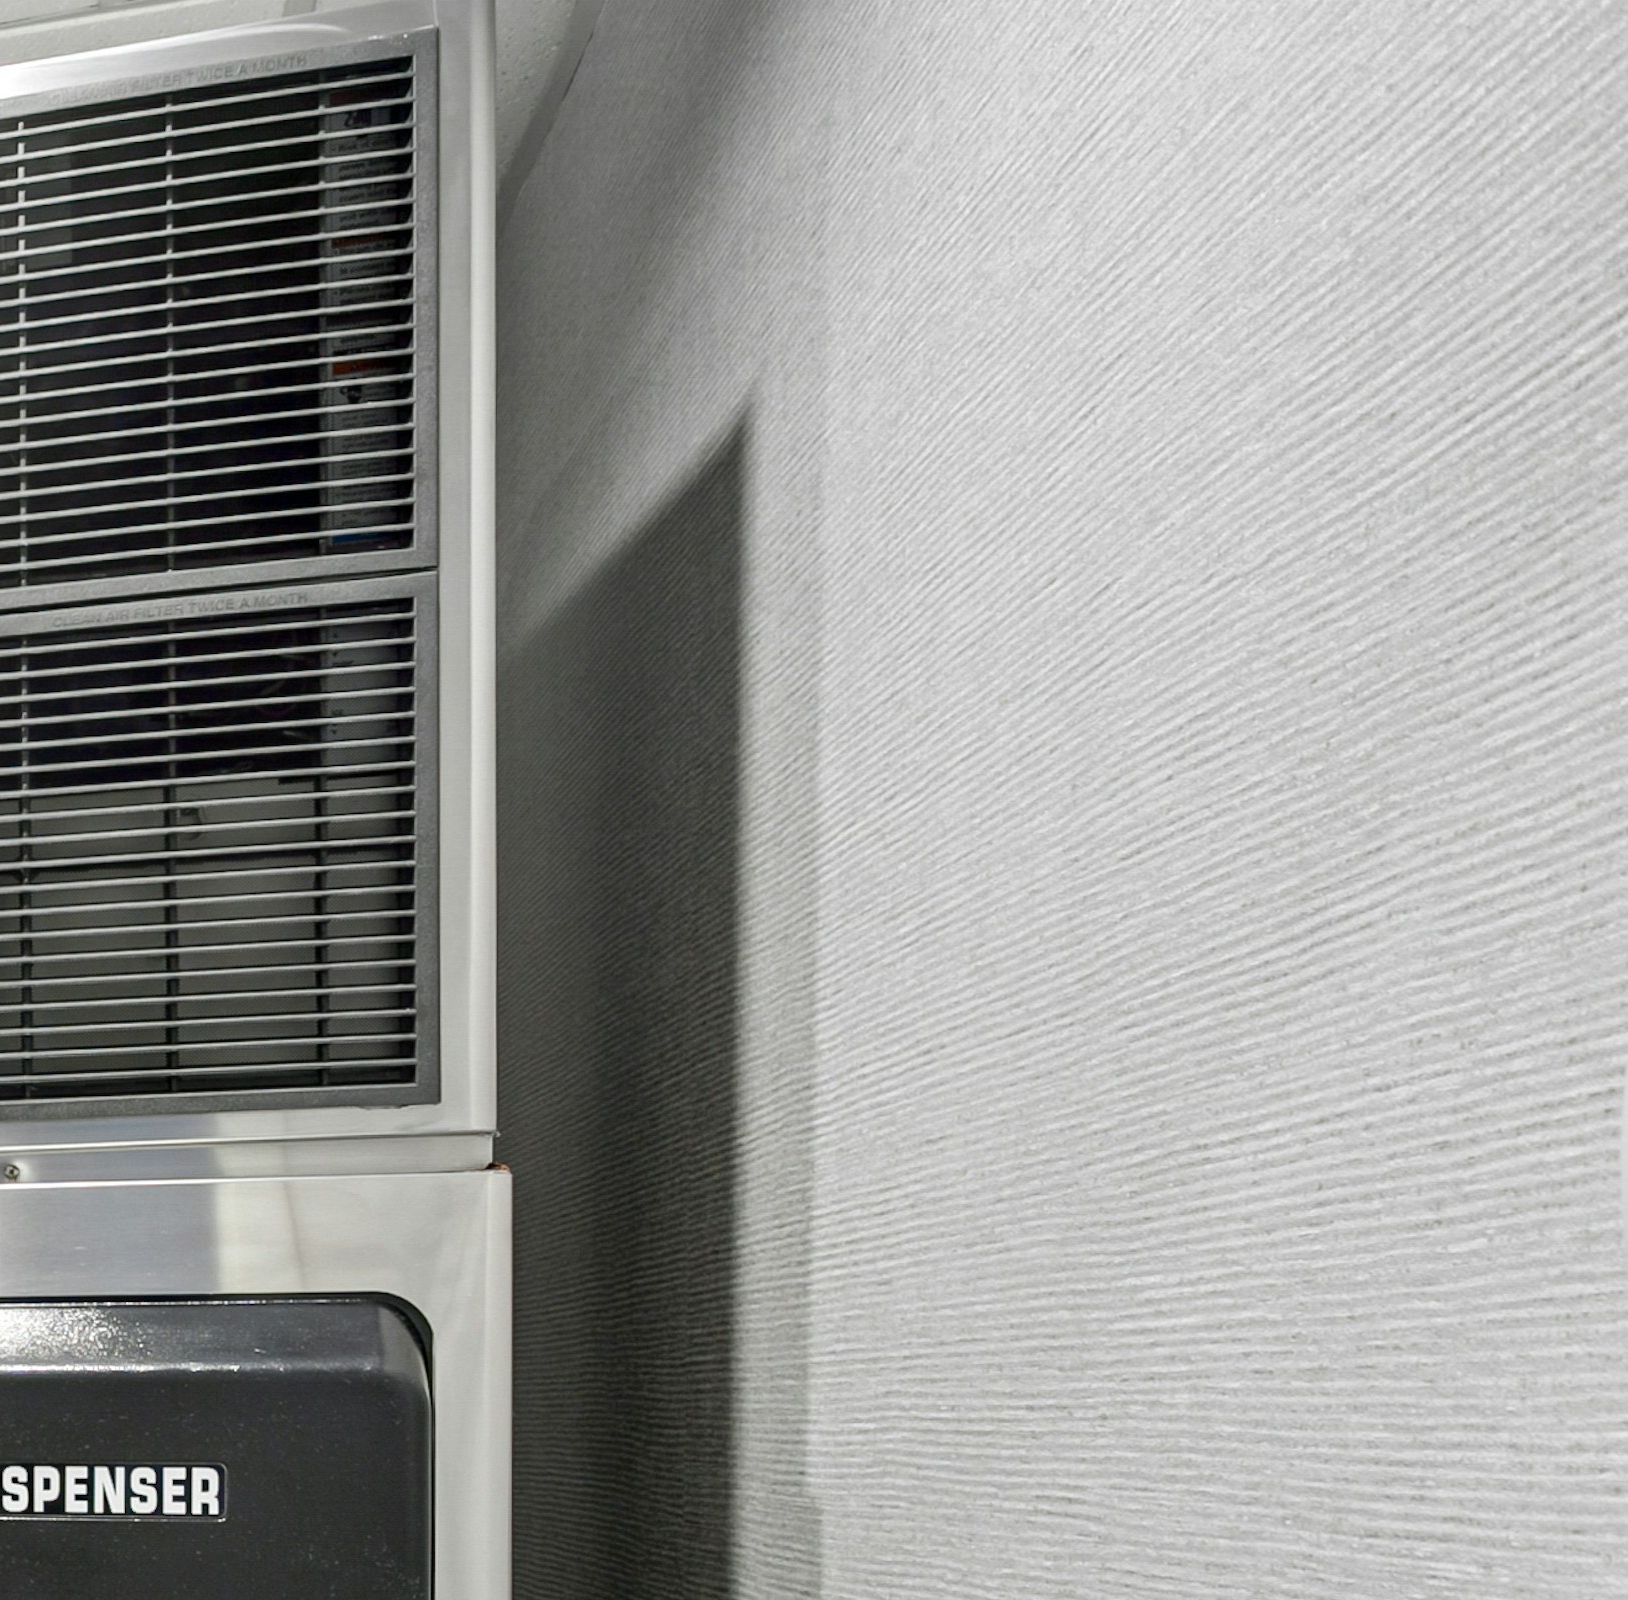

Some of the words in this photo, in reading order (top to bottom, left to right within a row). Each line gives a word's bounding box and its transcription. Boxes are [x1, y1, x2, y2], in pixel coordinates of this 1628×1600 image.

[185, 64, 233, 82] TWICE
[251, 54, 307, 73] MONTH
[51, 612, 101, 629] CLEAN
[105, 609, 130, 622] AIR
[133, 603, 184, 619] FILTER
[188, 598, 234, 614] TWICE
[239, 597, 250, 608] A
[253, 592, 308, 608] MONTH
